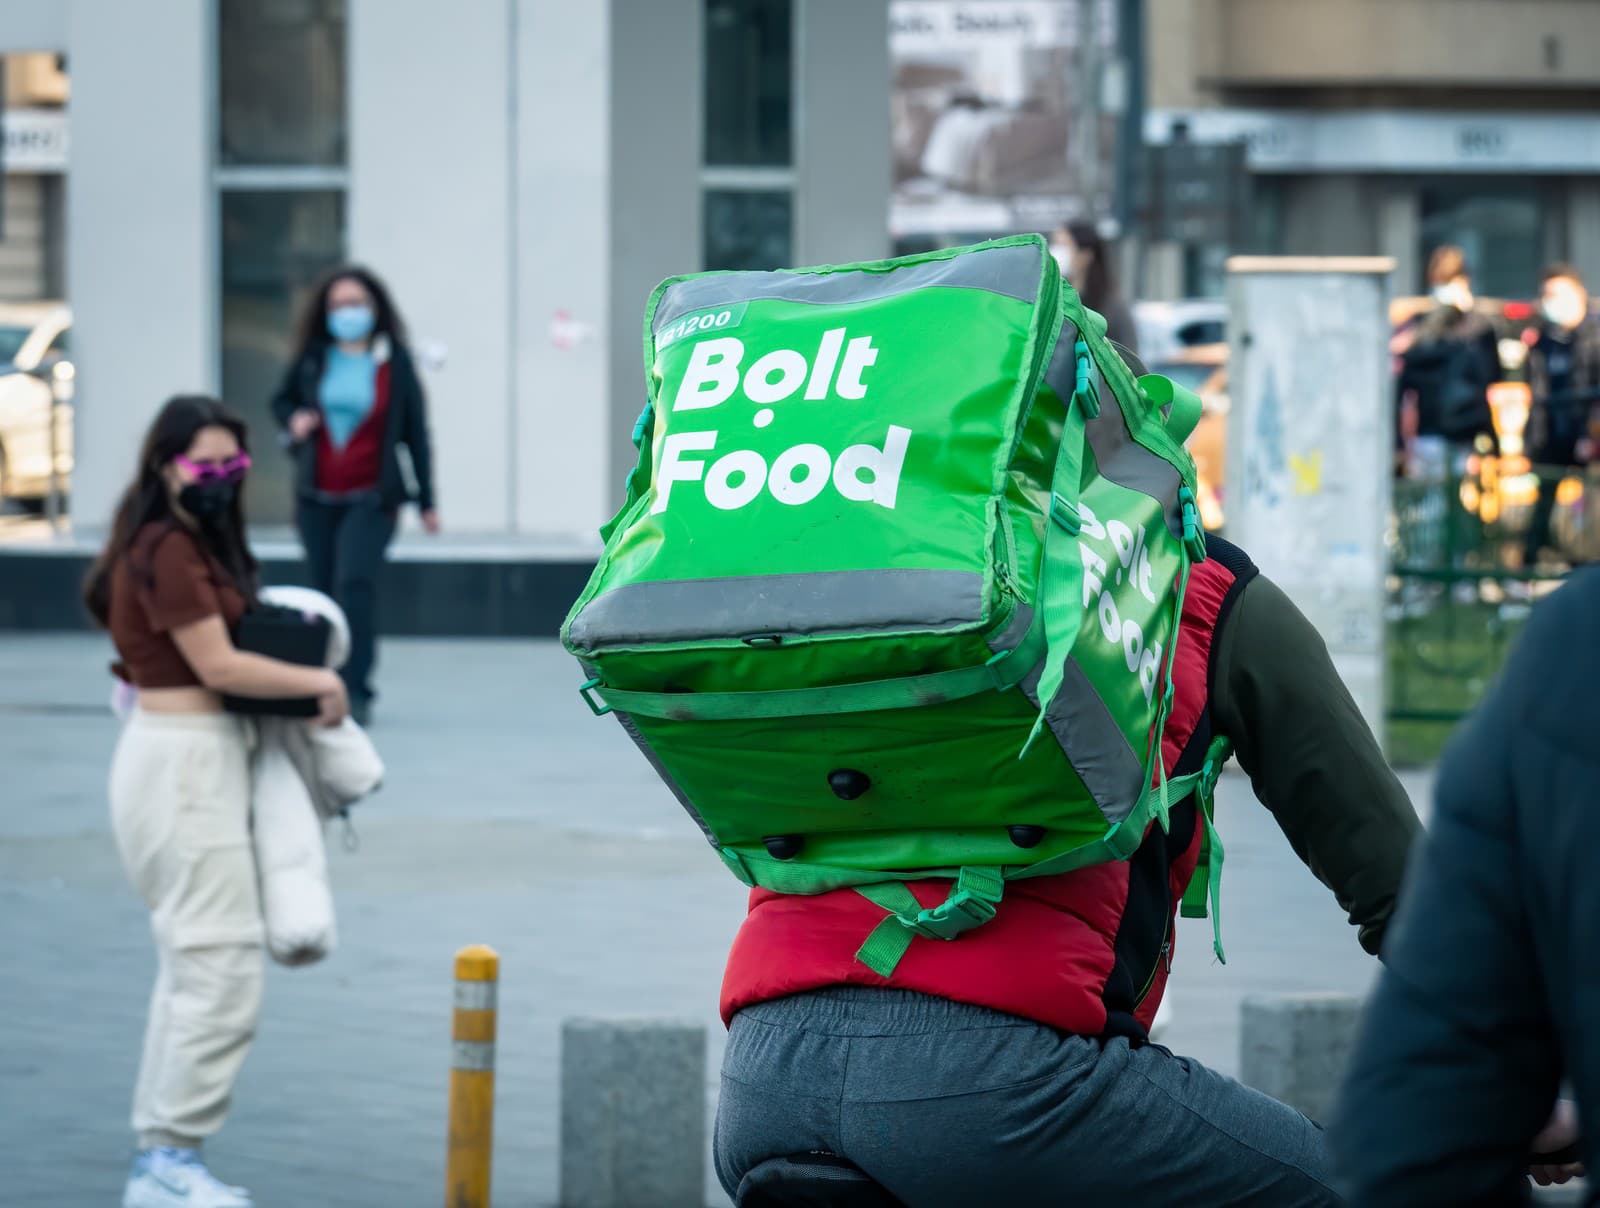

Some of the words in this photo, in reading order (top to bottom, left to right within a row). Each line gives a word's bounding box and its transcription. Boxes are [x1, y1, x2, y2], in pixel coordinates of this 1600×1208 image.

[672, 327, 879, 413] Bolt
[650, 425, 912, 515] Food
[1079, 541, 1163, 709] Food
